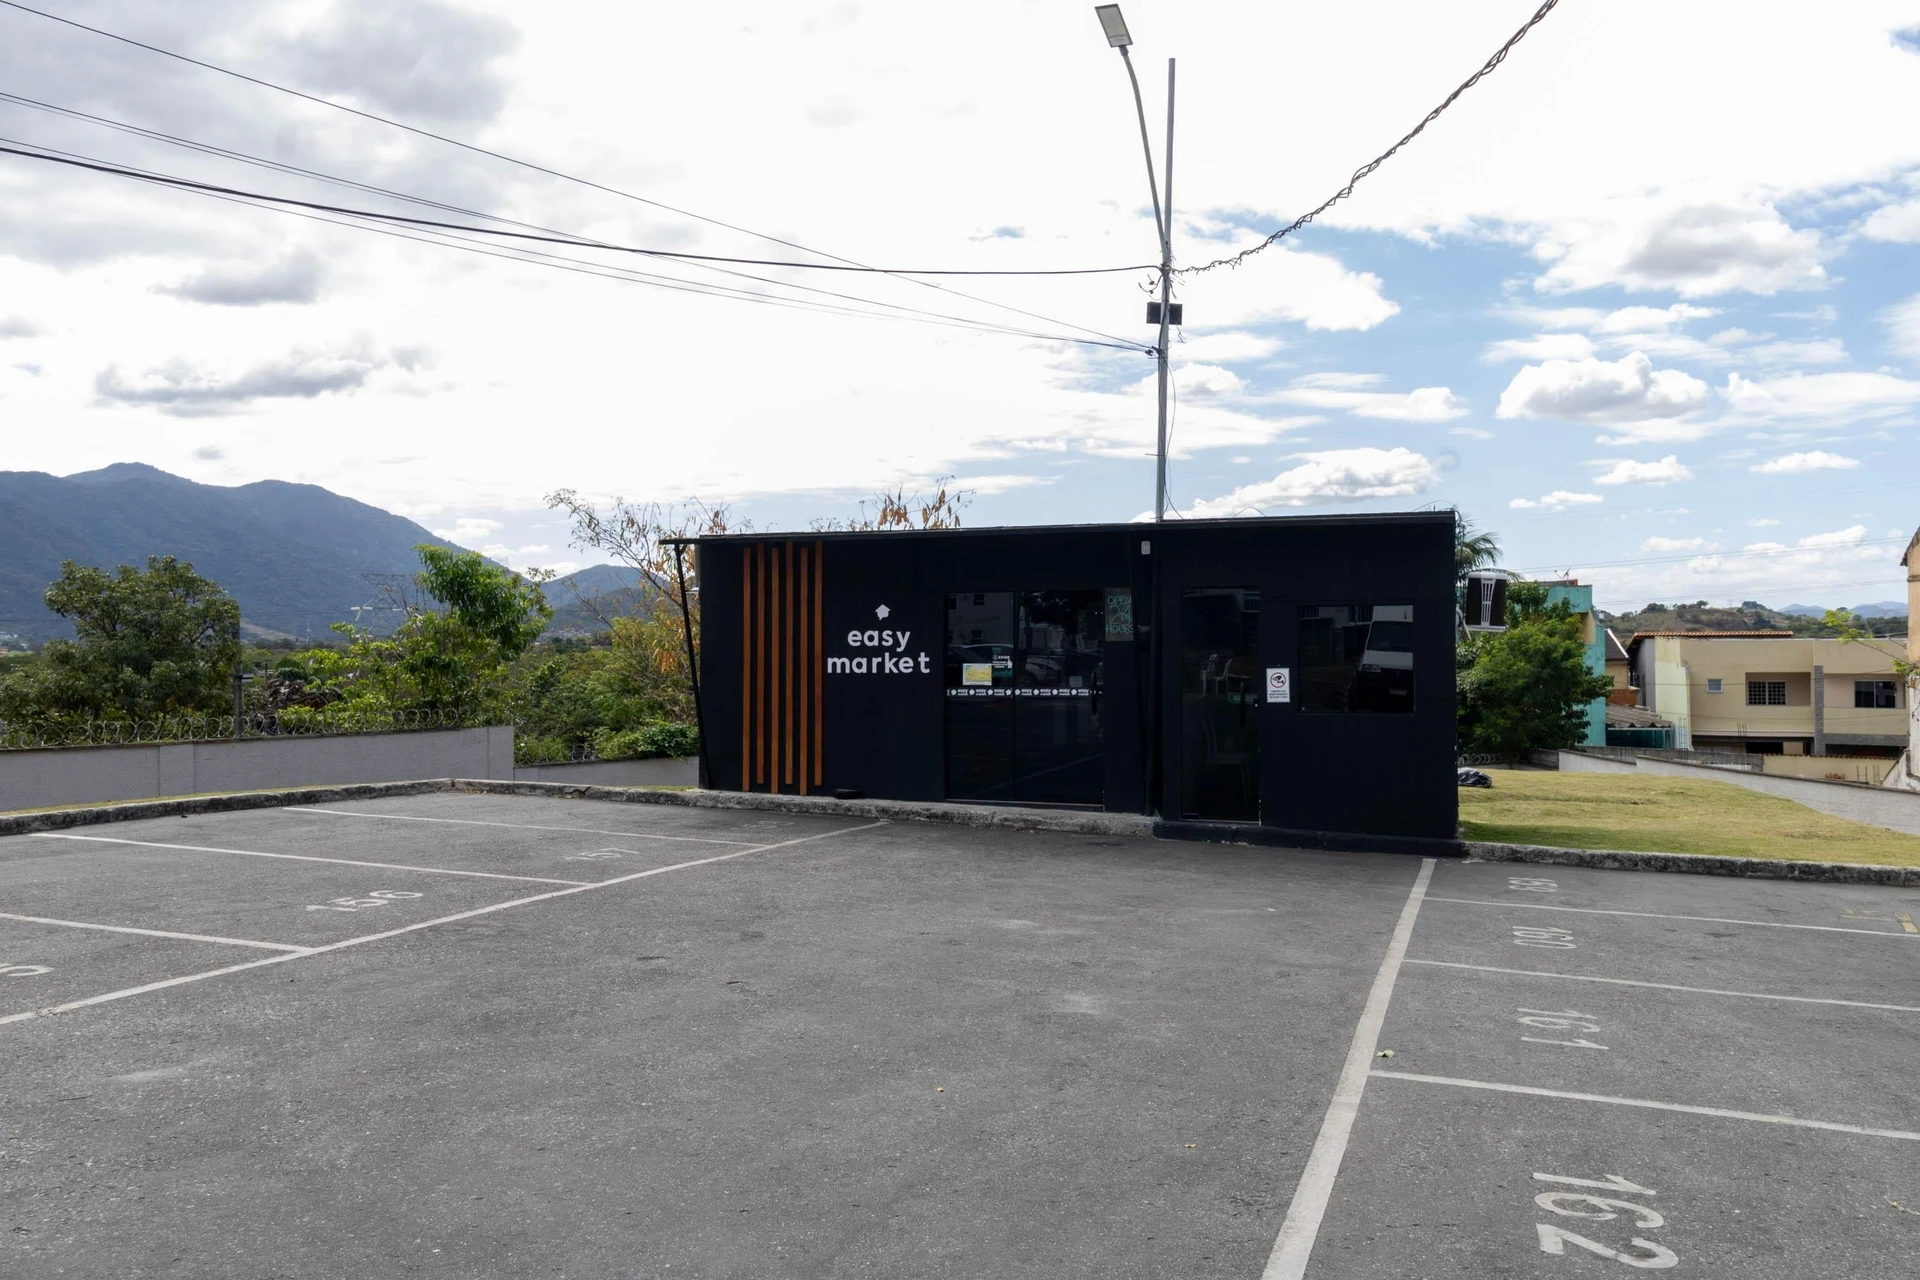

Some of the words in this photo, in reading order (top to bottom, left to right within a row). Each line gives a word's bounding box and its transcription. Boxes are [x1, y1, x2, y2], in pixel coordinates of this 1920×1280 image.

[1107, 595, 1131, 605] OPEN
[1109, 604, 1132, 625] 24
[1105, 624, 1133, 634] HOURS
[847, 629, 911, 652] easy
[827, 651, 931, 674] market
[1508, 876, 1558, 893] 159
[304, 890, 423, 912] 156
[1512, 925, 1577, 949] 160
[1517, 1007, 1610, 1050] 161
[1532, 1171, 1679, 1269] 162
